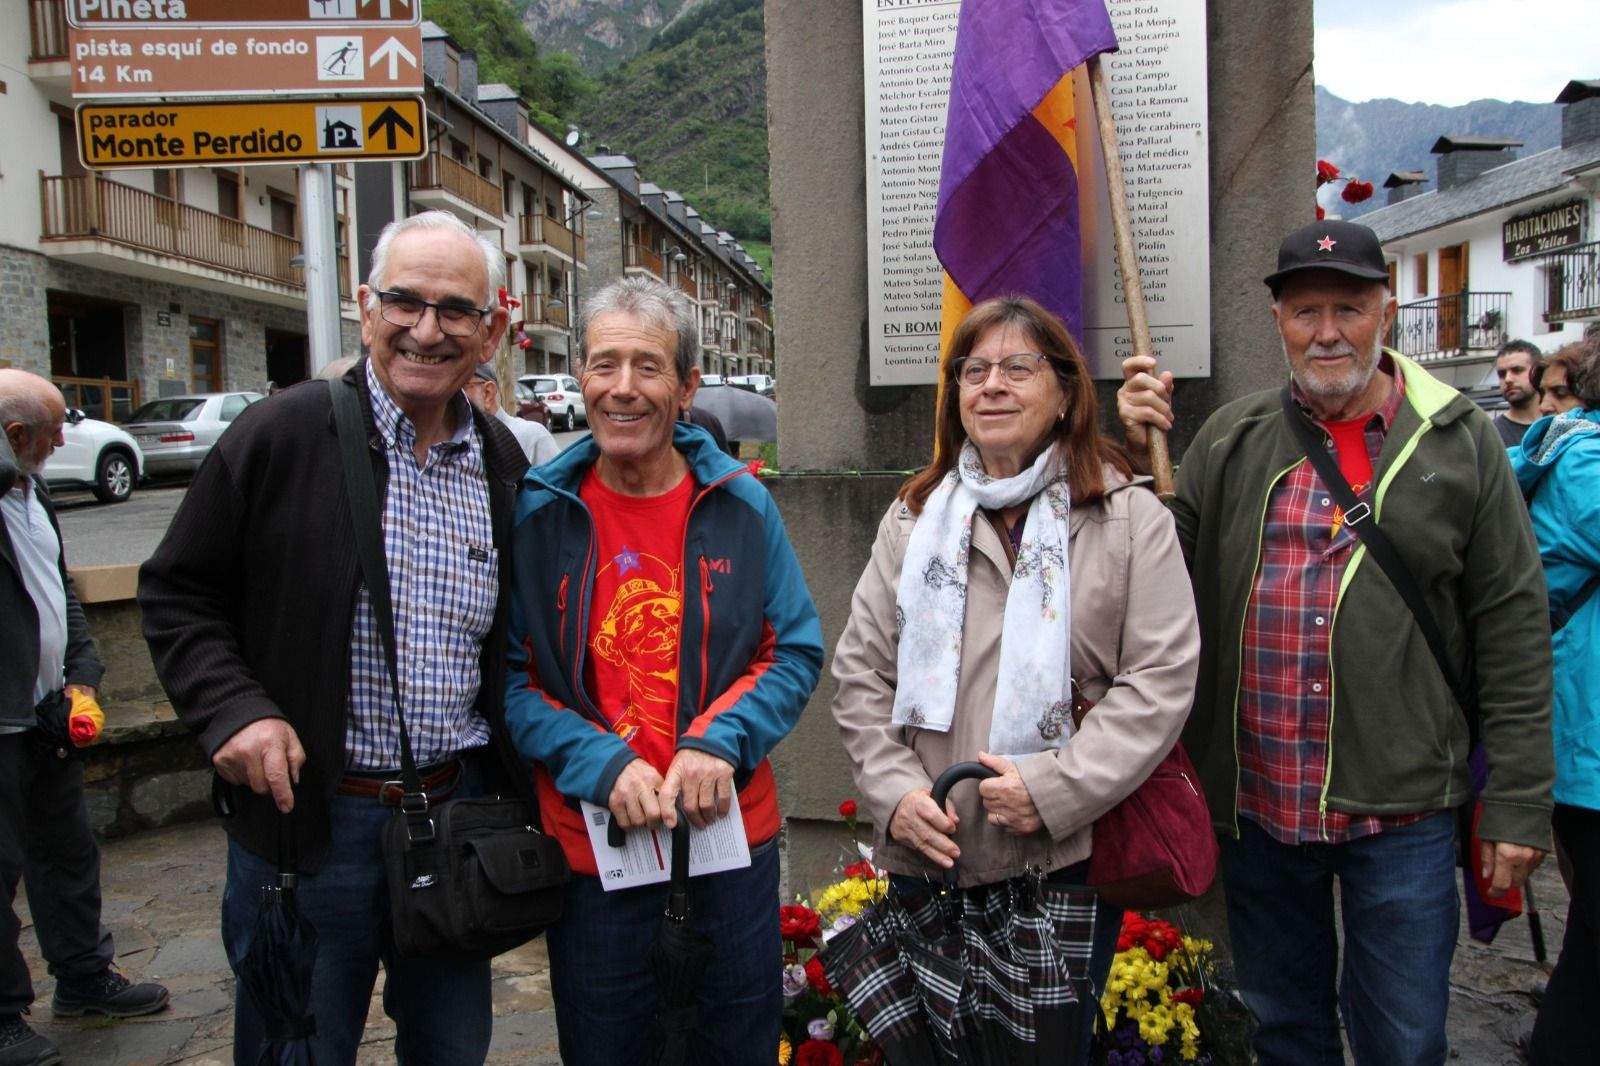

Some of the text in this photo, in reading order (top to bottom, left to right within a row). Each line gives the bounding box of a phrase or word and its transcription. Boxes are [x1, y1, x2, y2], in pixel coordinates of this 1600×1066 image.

[78, 0, 188, 20] Pineta
[1110, 6, 1158, 17] Casa Roda
[878, 18, 896, 27] José
[899, 16, 929, 25] Baquer
[1135, 20, 1143, 28] la
[1146, 16, 1176, 27] Monja
[878, 30, 896, 39] José
[914, 27, 944, 36] Baquer
[1135, 30, 1179, 41] Sucarrina
[75, 36, 309, 61] pista esquí de fondo
[879, 42, 896, 52] José
[1136, 44, 1168, 54] Campé
[879, 54, 913, 63] Lorenzo
[879, 62, 952, 76] Antonio Costa Av
[1111, 59, 1161, 69] Casa Mayo
[78, 65, 153, 83] 14 Km
[1111, 71, 1169, 82] Casa Campo
[879, 75, 951, 88] Antonio De Anto
[1111, 83, 1178, 95] Casa Panablar
[880, 91, 915, 101] Melchor
[1150, 97, 1188, 105] Ramona
[880, 102, 946, 113] Modesto Ferrer
[880, 114, 938, 126] Mateo Gistau
[1112, 110, 1171, 121] Casa Vicenta
[90, 111, 178, 132] parador
[1135, 124, 1146, 132] de
[1149, 122, 1201, 131] carabinero
[880, 126, 944, 139] Juan Gistau Ca
[91, 127, 302, 158] Monte Perdido
[1137, 135, 1172, 145] Pallaral
[880, 141, 910, 151] Andrés
[881, 154, 914, 163] Antonio
[1120, 148, 1189, 161] ijo del médico
[881, 164, 941, 175] Antonio Mont
[1137, 162, 1191, 172] Matazueras
[881, 178, 915, 188] Antonio
[1137, 176, 1162, 185] Barta
[882, 192, 916, 200] Lorenzo
[1138, 188, 1183, 199] Fulgencio
[882, 203, 910, 213] Ismael
[1138, 201, 1168, 211] Mairal
[882, 218, 900, 227] José
[1138, 215, 1168, 224] Mairal
[1505, 205, 1580, 243] HABITACIONES
[883, 229, 908, 238] Pedro
[1138, 228, 1175, 237] Saludas
[883, 240, 933, 251] José Saluda
[1515, 244, 1530, 256] Los
[883, 253, 932, 263] José Solans
[883, 265, 943, 276] Domingo Sola
[913, 278, 941, 286] Solans
[913, 290, 941, 298] Solans
[884, 304, 918, 313] Antonio
[884, 323, 900, 334] EN
[884, 344, 924, 352] Victorino
[885, 356, 922, 365] Leontina
